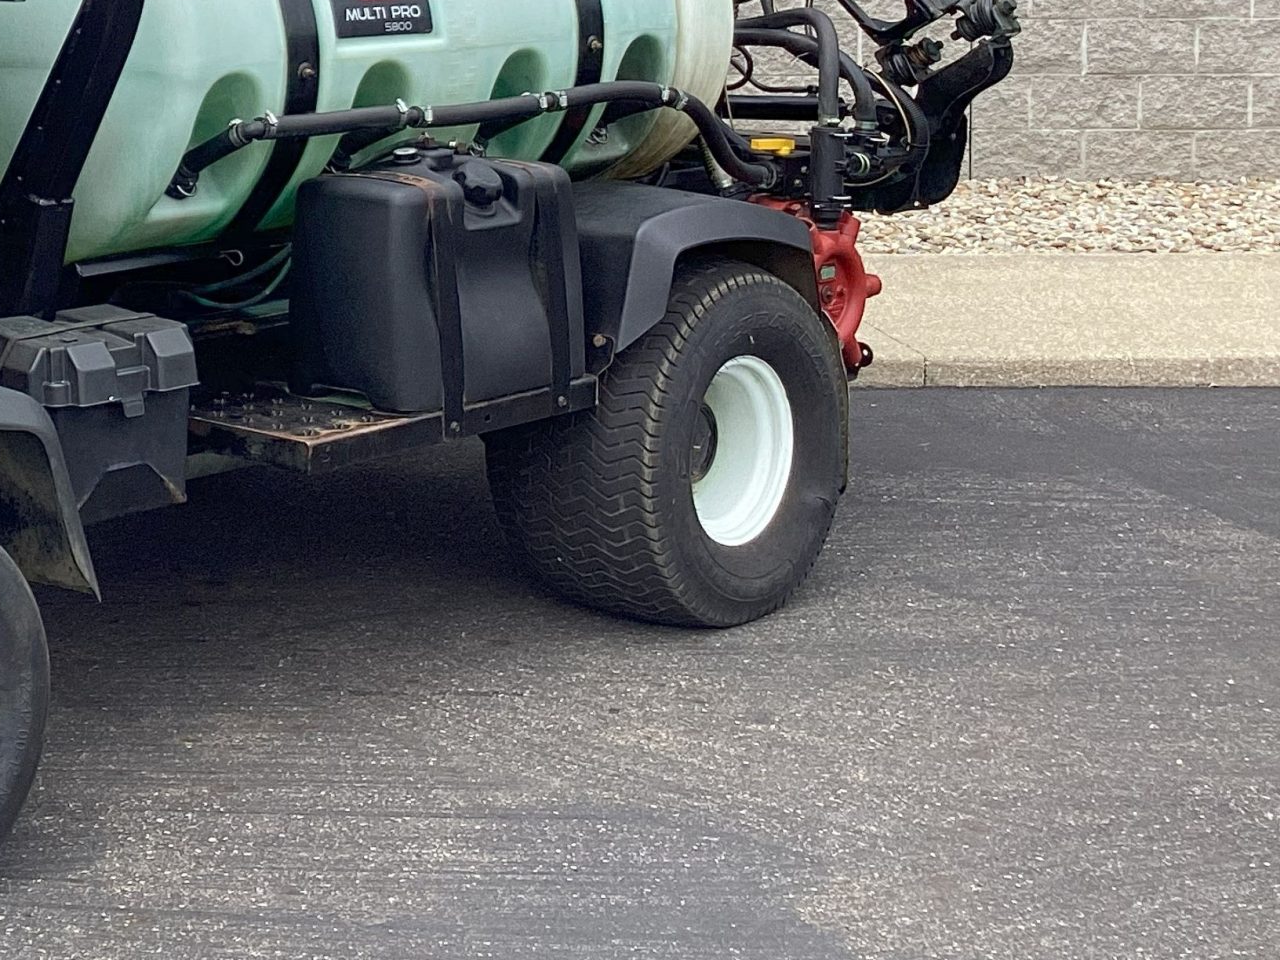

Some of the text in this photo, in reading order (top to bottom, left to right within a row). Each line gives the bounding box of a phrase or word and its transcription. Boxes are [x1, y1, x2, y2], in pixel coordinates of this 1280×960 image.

[345, 5, 421, 21] MULTI PRO
[385, 21, 413, 32] 5800
